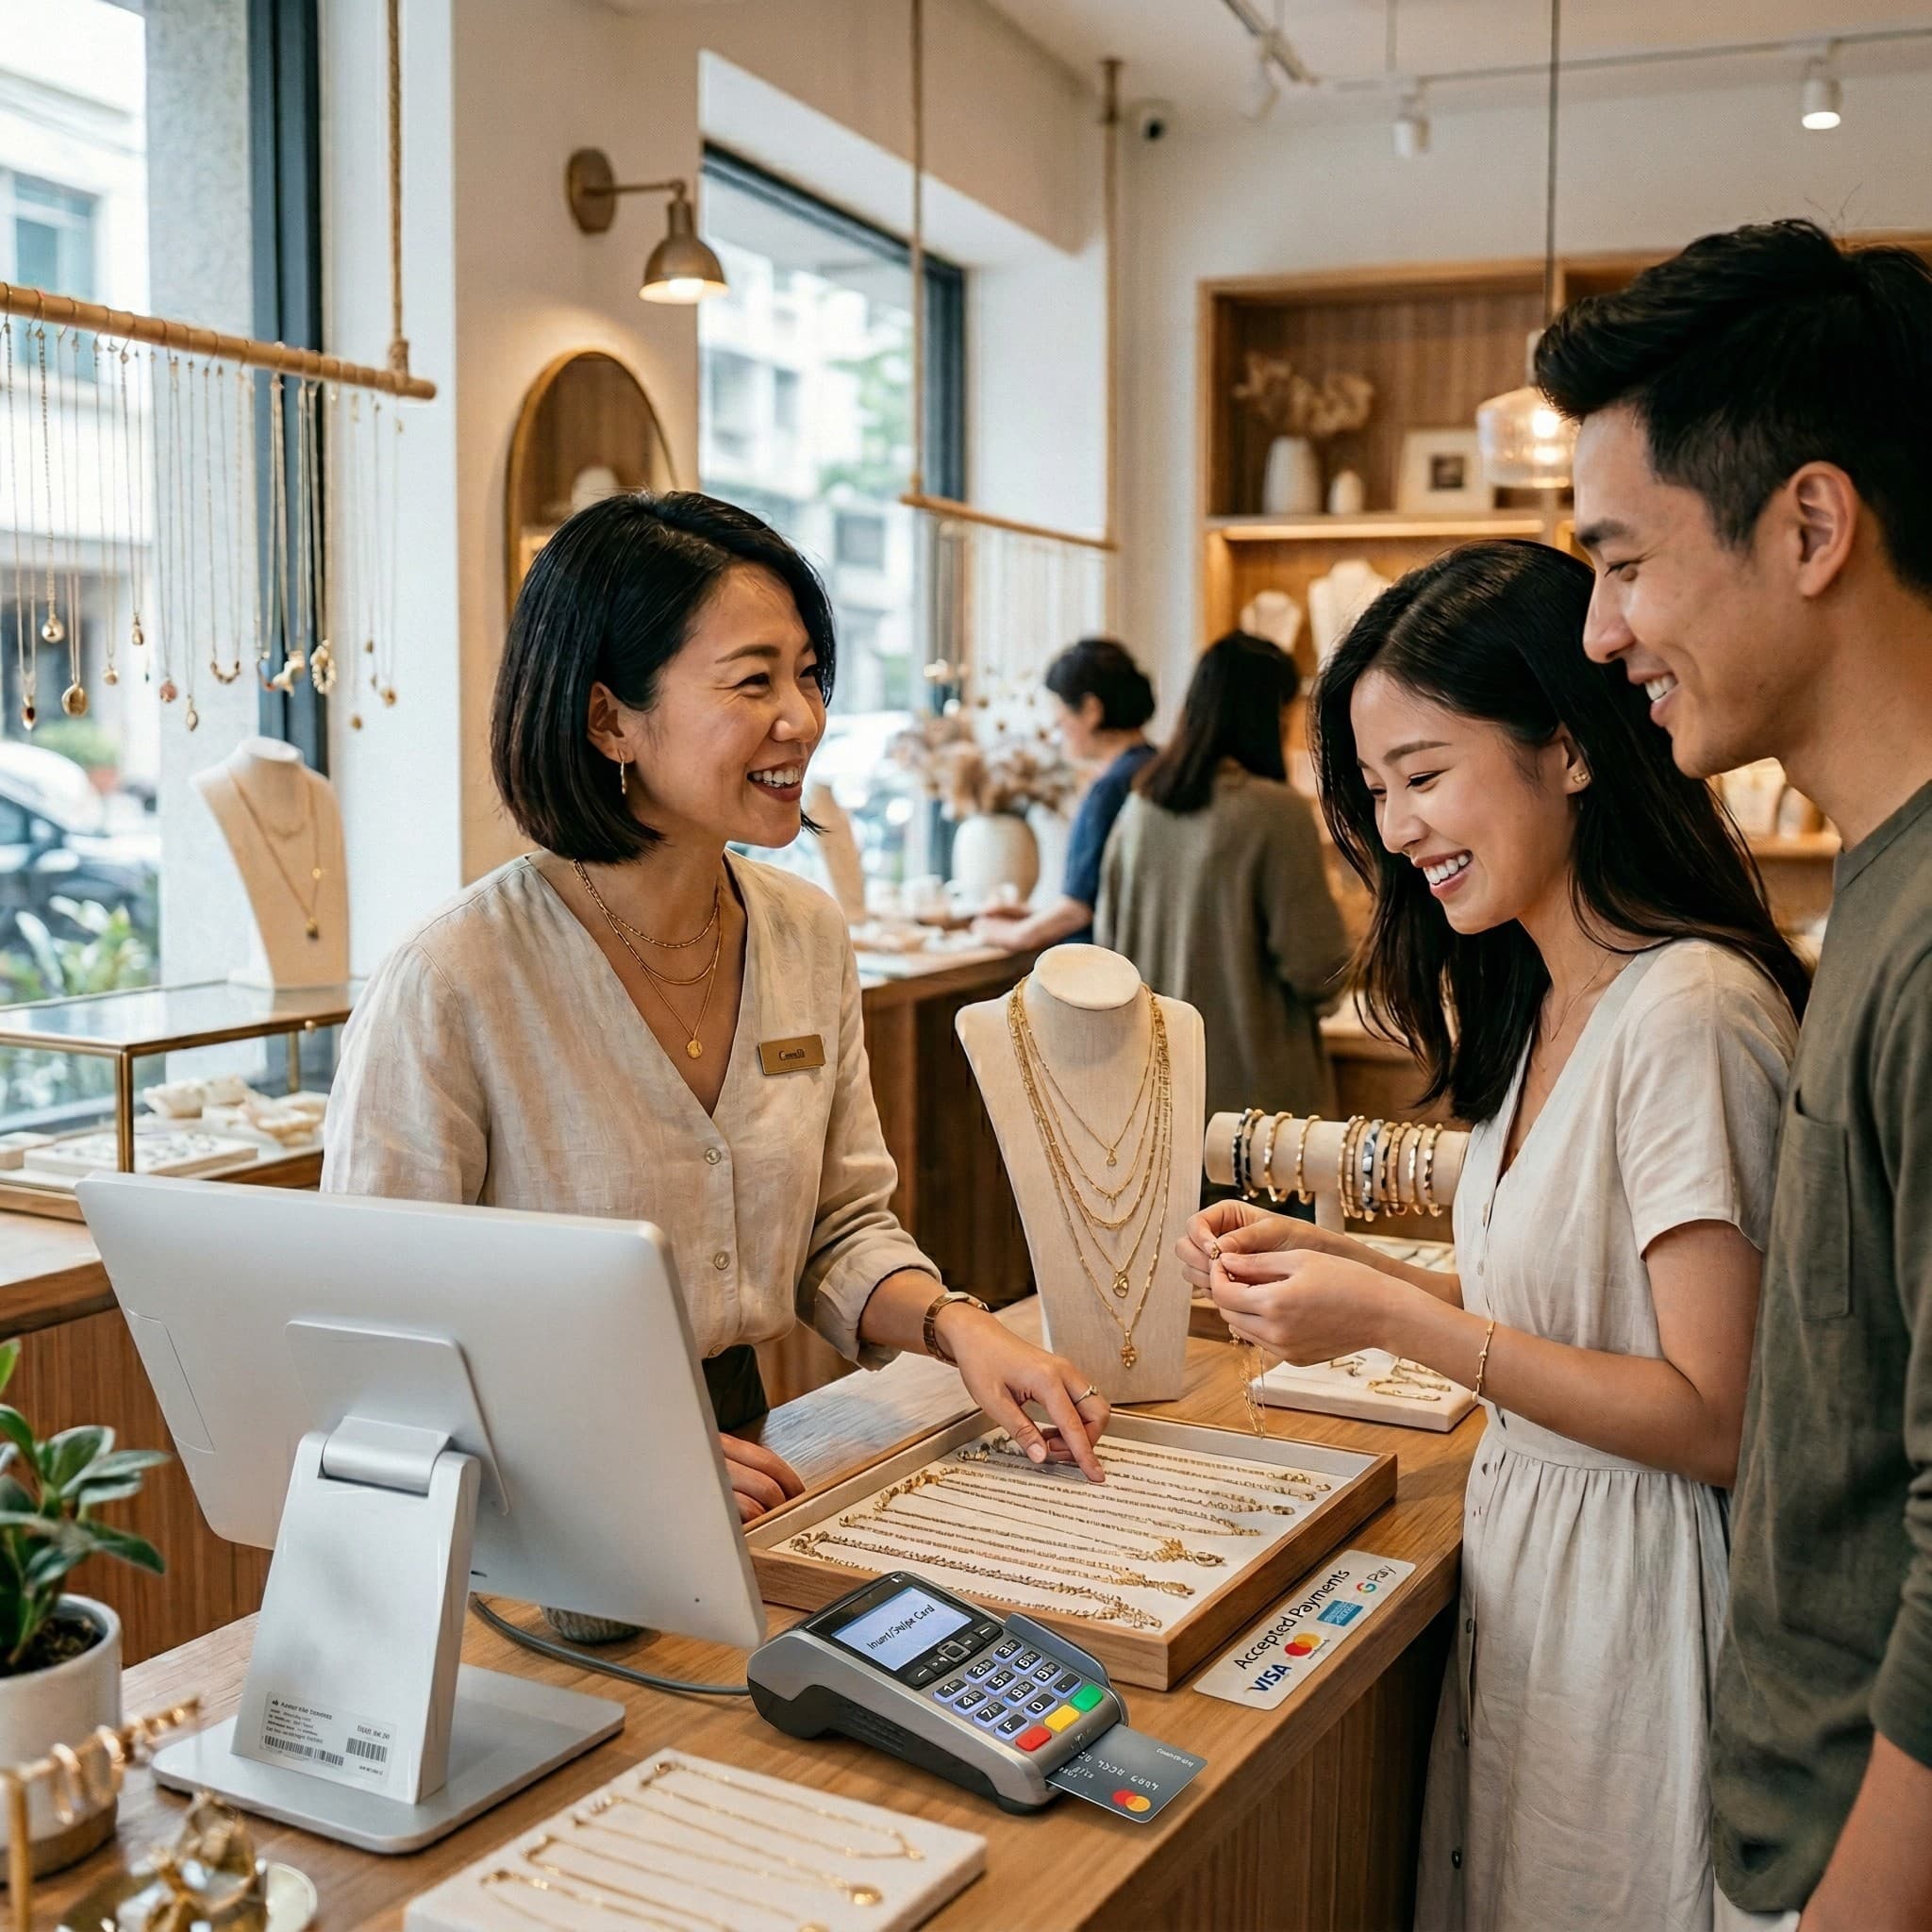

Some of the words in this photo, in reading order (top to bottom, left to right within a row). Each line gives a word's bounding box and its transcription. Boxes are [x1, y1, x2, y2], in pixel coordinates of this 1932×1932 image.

[913, 1604, 936, 1620] Card
[1234, 1617, 1297, 1669] Accepted
[1289, 1570, 1350, 1618] Payments
[943, 1684, 955, 1693] 1
[973, 1663, 986, 1676] 2
[999, 1643, 1012, 1657] 3
[1248, 1664, 1292, 1691] VISA
[962, 1696, 974, 1706] 4
[993, 1674, 1005, 1687] 5
[981, 1708, 992, 1719] 7
[1004, 1720, 1014, 1731] F
